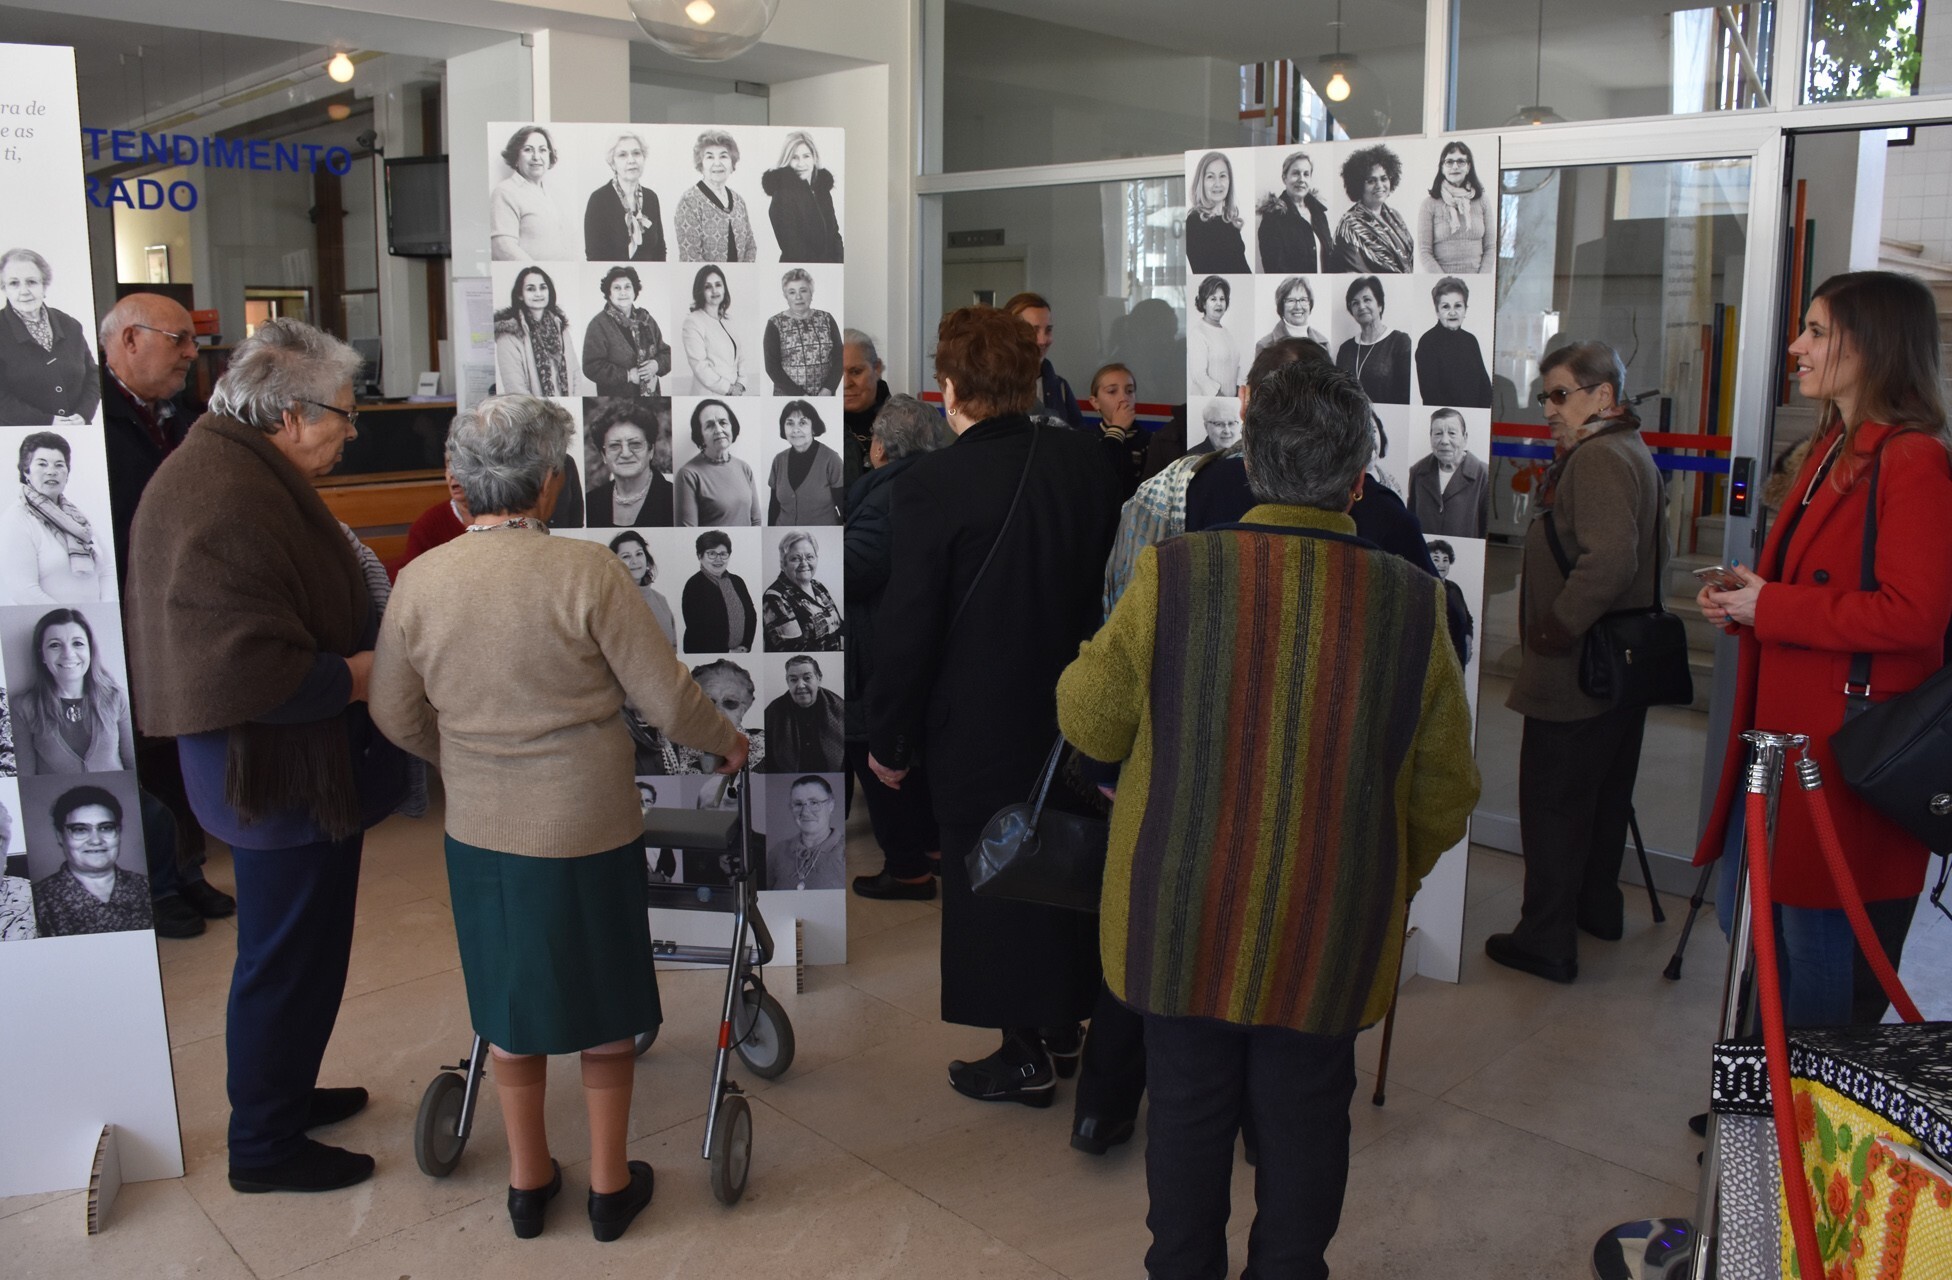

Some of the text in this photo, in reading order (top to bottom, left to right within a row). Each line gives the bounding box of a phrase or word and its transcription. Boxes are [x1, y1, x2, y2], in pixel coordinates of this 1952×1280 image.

[26, 100, 46, 116] de
[14, 127, 34, 138] as
[5, 146, 22, 163] ti,
[82, 127, 352, 176] TENDIMENTO
